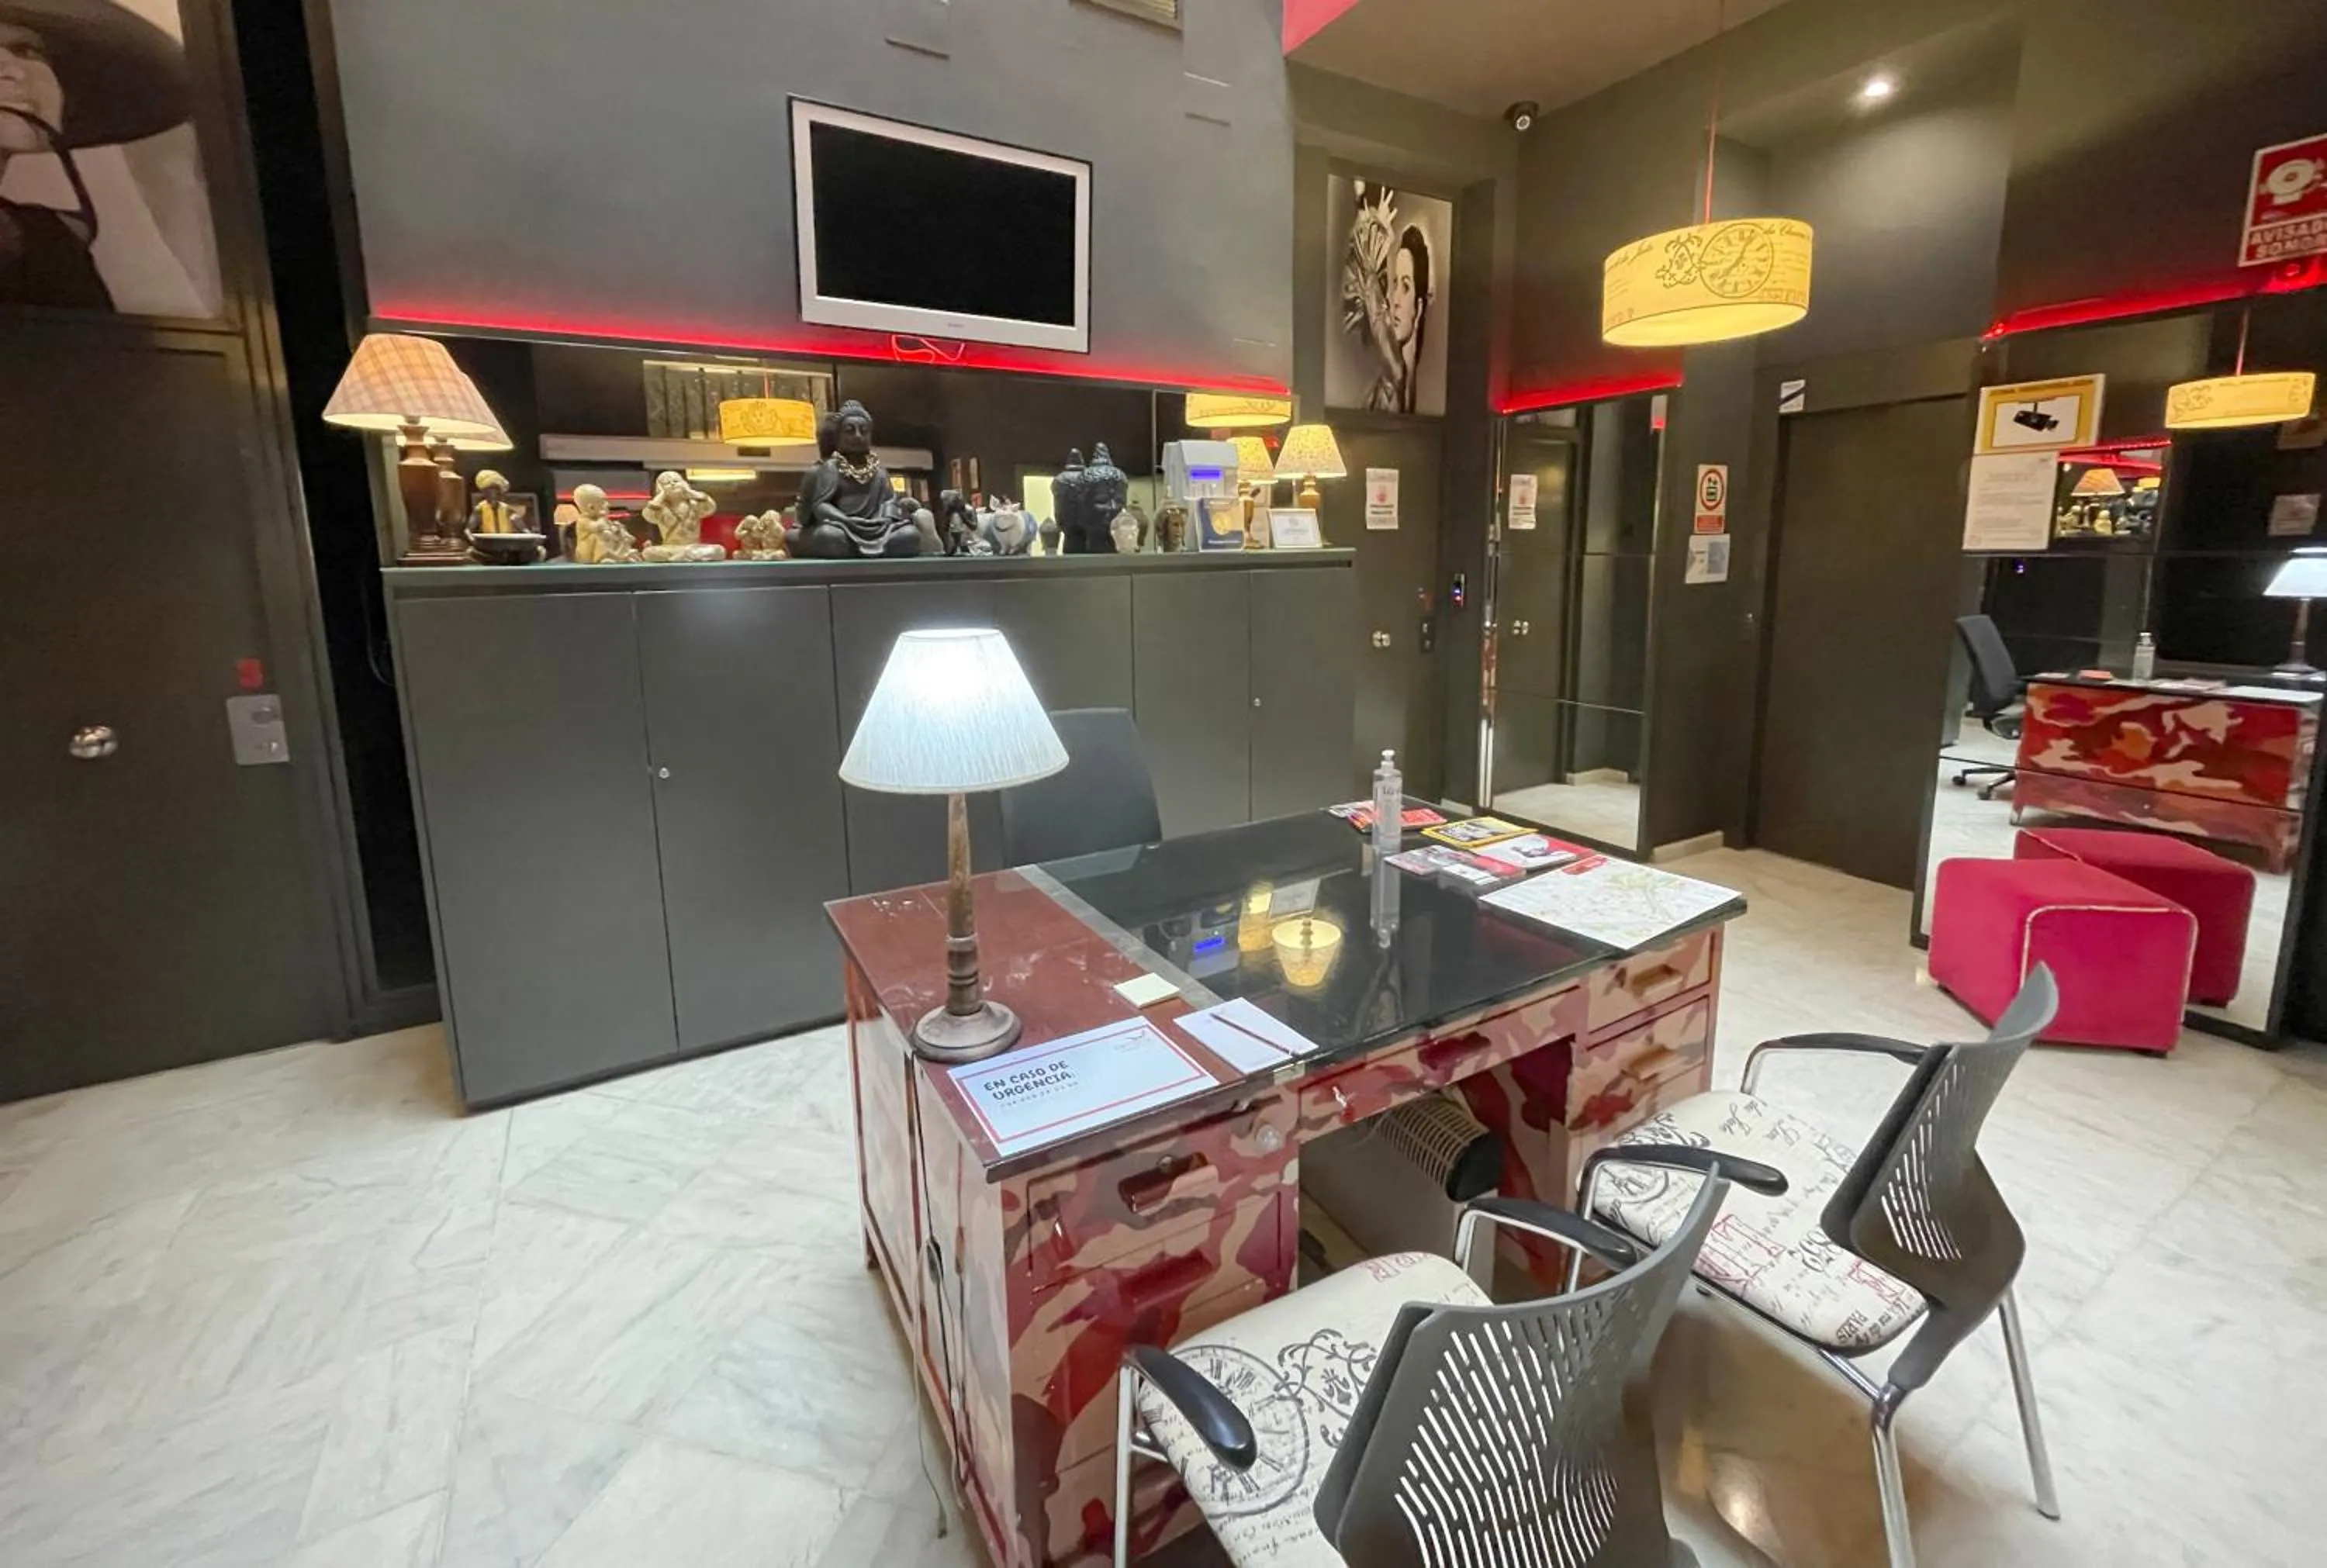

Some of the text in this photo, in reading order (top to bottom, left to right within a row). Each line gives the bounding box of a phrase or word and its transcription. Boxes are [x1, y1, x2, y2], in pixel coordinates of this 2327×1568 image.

[2251, 220, 2327, 244] AVISAD
[984, 1060, 1068, 1091] EN CASO DE
[992, 1071, 1071, 1100] URGENCIA
[1836, 1310, 1869, 1342] PARIS
